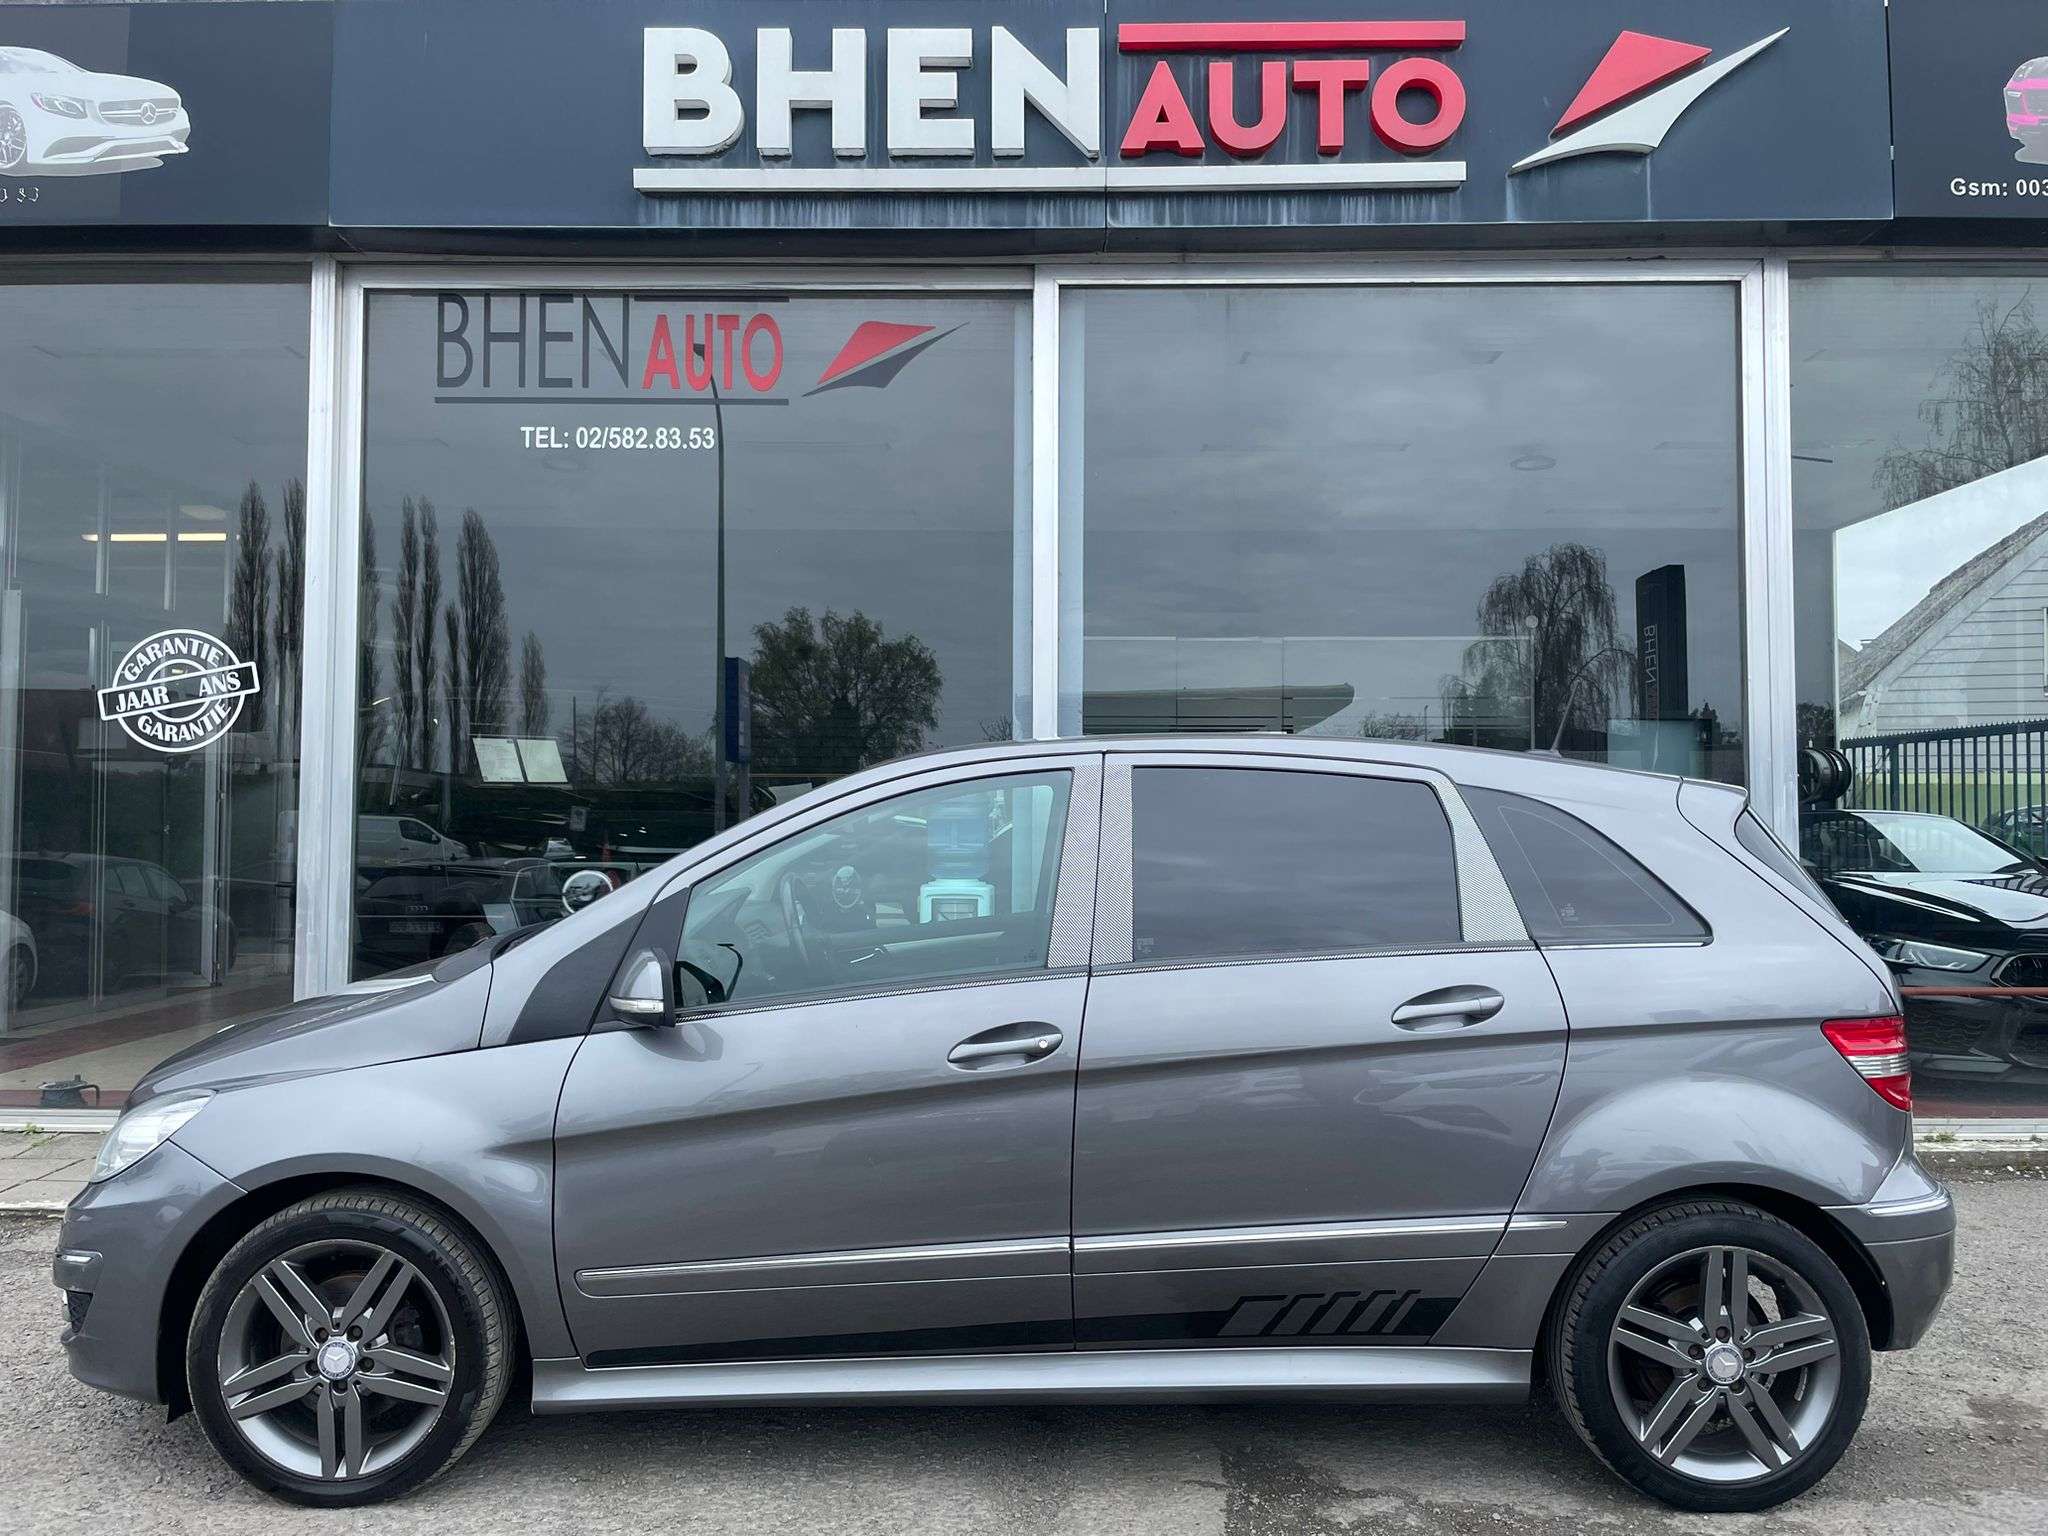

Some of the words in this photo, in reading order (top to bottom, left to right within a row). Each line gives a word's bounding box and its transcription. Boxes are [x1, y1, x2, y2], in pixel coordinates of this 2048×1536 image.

[643, 26, 1100, 157] BHEN
[1119, 56, 1467, 157] AUTO
[1950, 177, 2008, 197] Gsm:
[436, 292, 630, 389] BHEN
[641, 312, 784, 393] AUTO
[520, 426, 569, 449] TEL:
[575, 426, 715, 450] 02/582.83.53
[121, 637, 224, 682] GARANTIE
[115, 685, 170, 713] JAAR
[199, 671, 242, 698] ANS
[137, 697, 232, 743] GARANTIE
